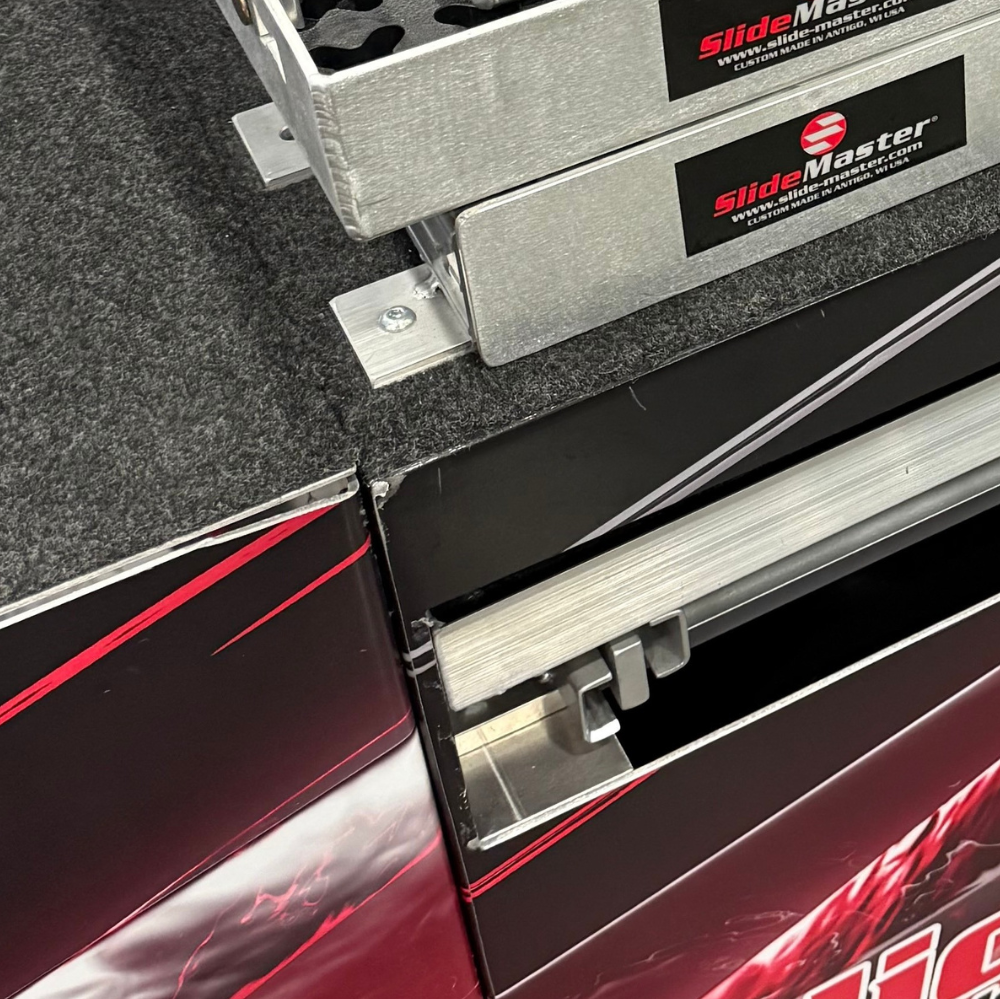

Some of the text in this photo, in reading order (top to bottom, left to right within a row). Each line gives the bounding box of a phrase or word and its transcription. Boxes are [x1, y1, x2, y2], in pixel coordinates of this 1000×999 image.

[733, 5, 906, 72] CUSTOM MADE IN ANTIGO, WI USA
[730, 140, 923, 224] www.slide-master.com
[747, 157, 910, 226] CUSTOM MADE IN ANTIGO, WI USA
